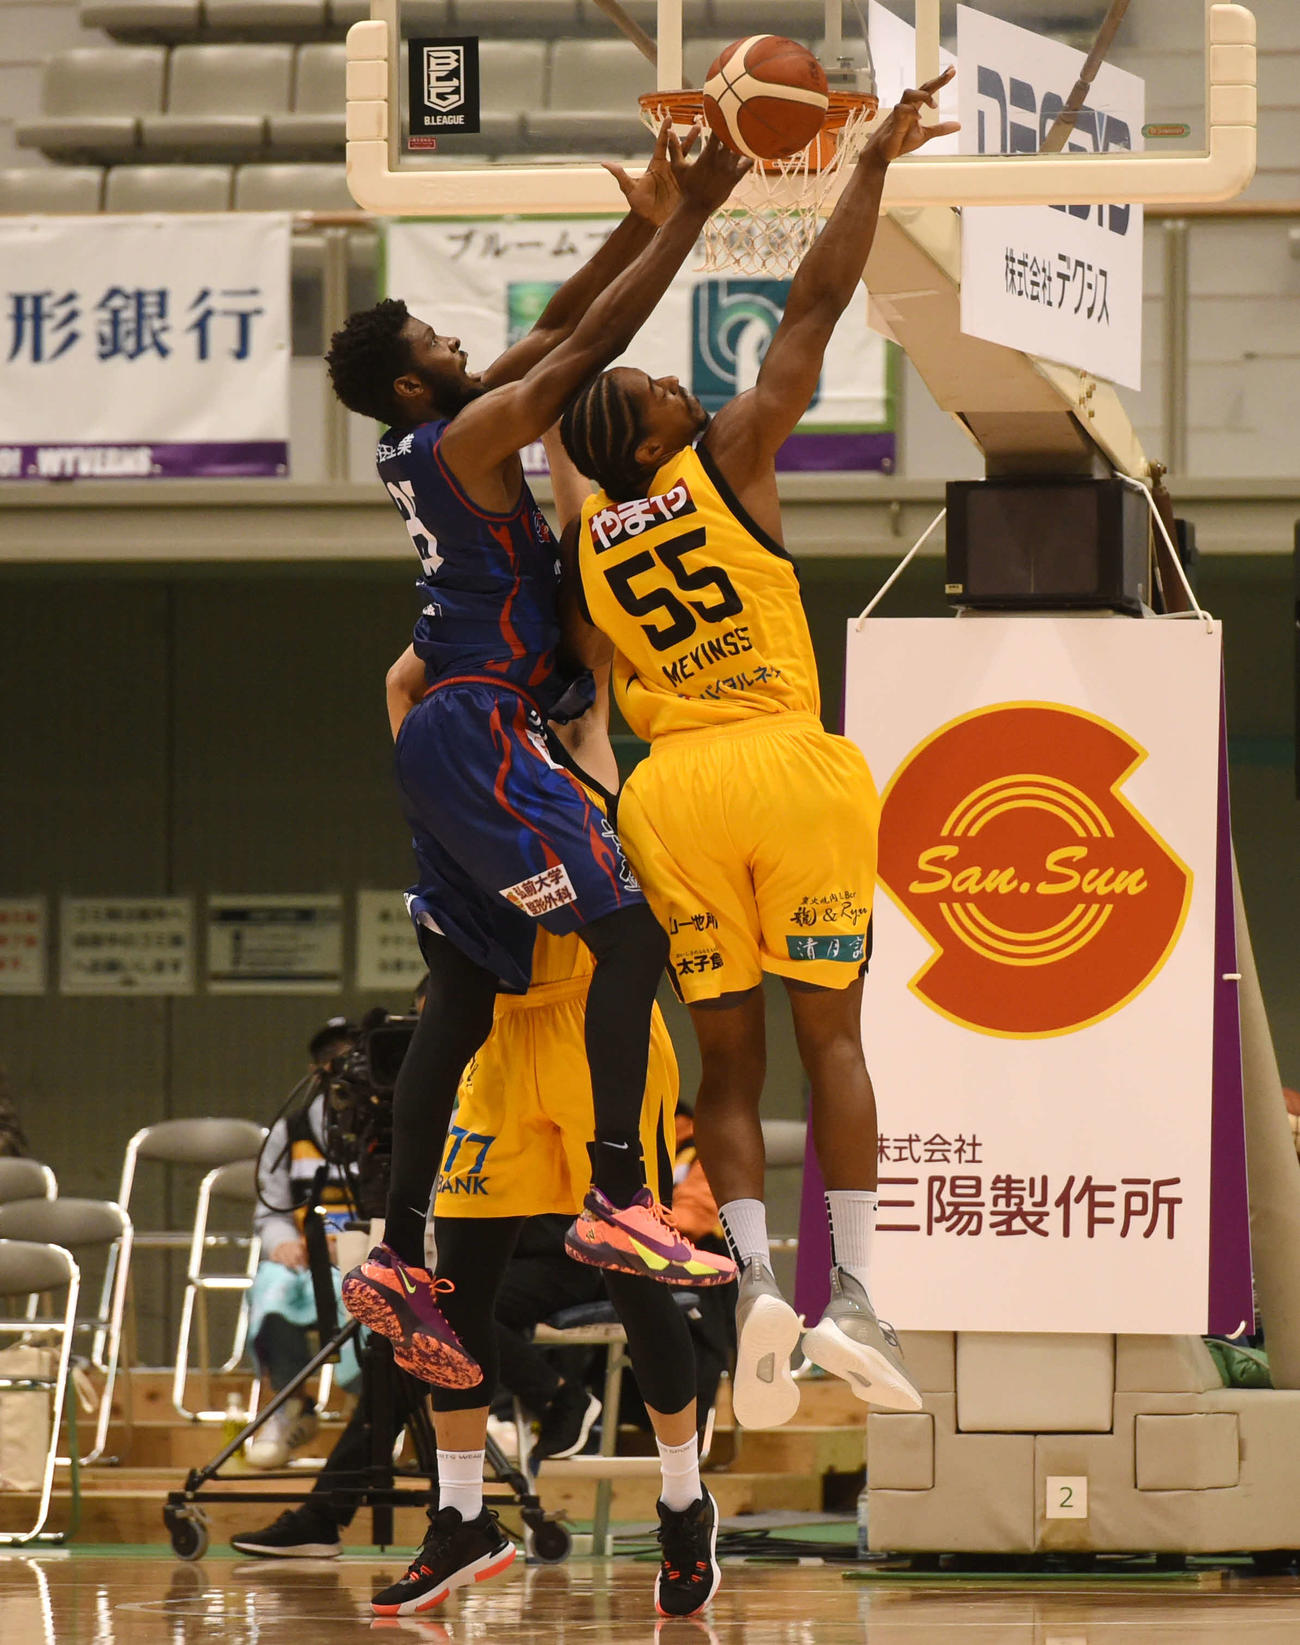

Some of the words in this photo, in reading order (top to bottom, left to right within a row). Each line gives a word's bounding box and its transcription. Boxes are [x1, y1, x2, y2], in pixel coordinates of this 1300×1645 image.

[424, 115, 464, 126] B.LEAGUE
[8, 285, 264, 364] 形銀行
[603, 526, 743, 651] 55
[662, 626, 753, 688] MEYINSS
[908, 844, 1148, 895] San.Sun
[875, 1174, 1183, 1240] 三陽製作所
[1060, 1486, 1073, 1508] 2
